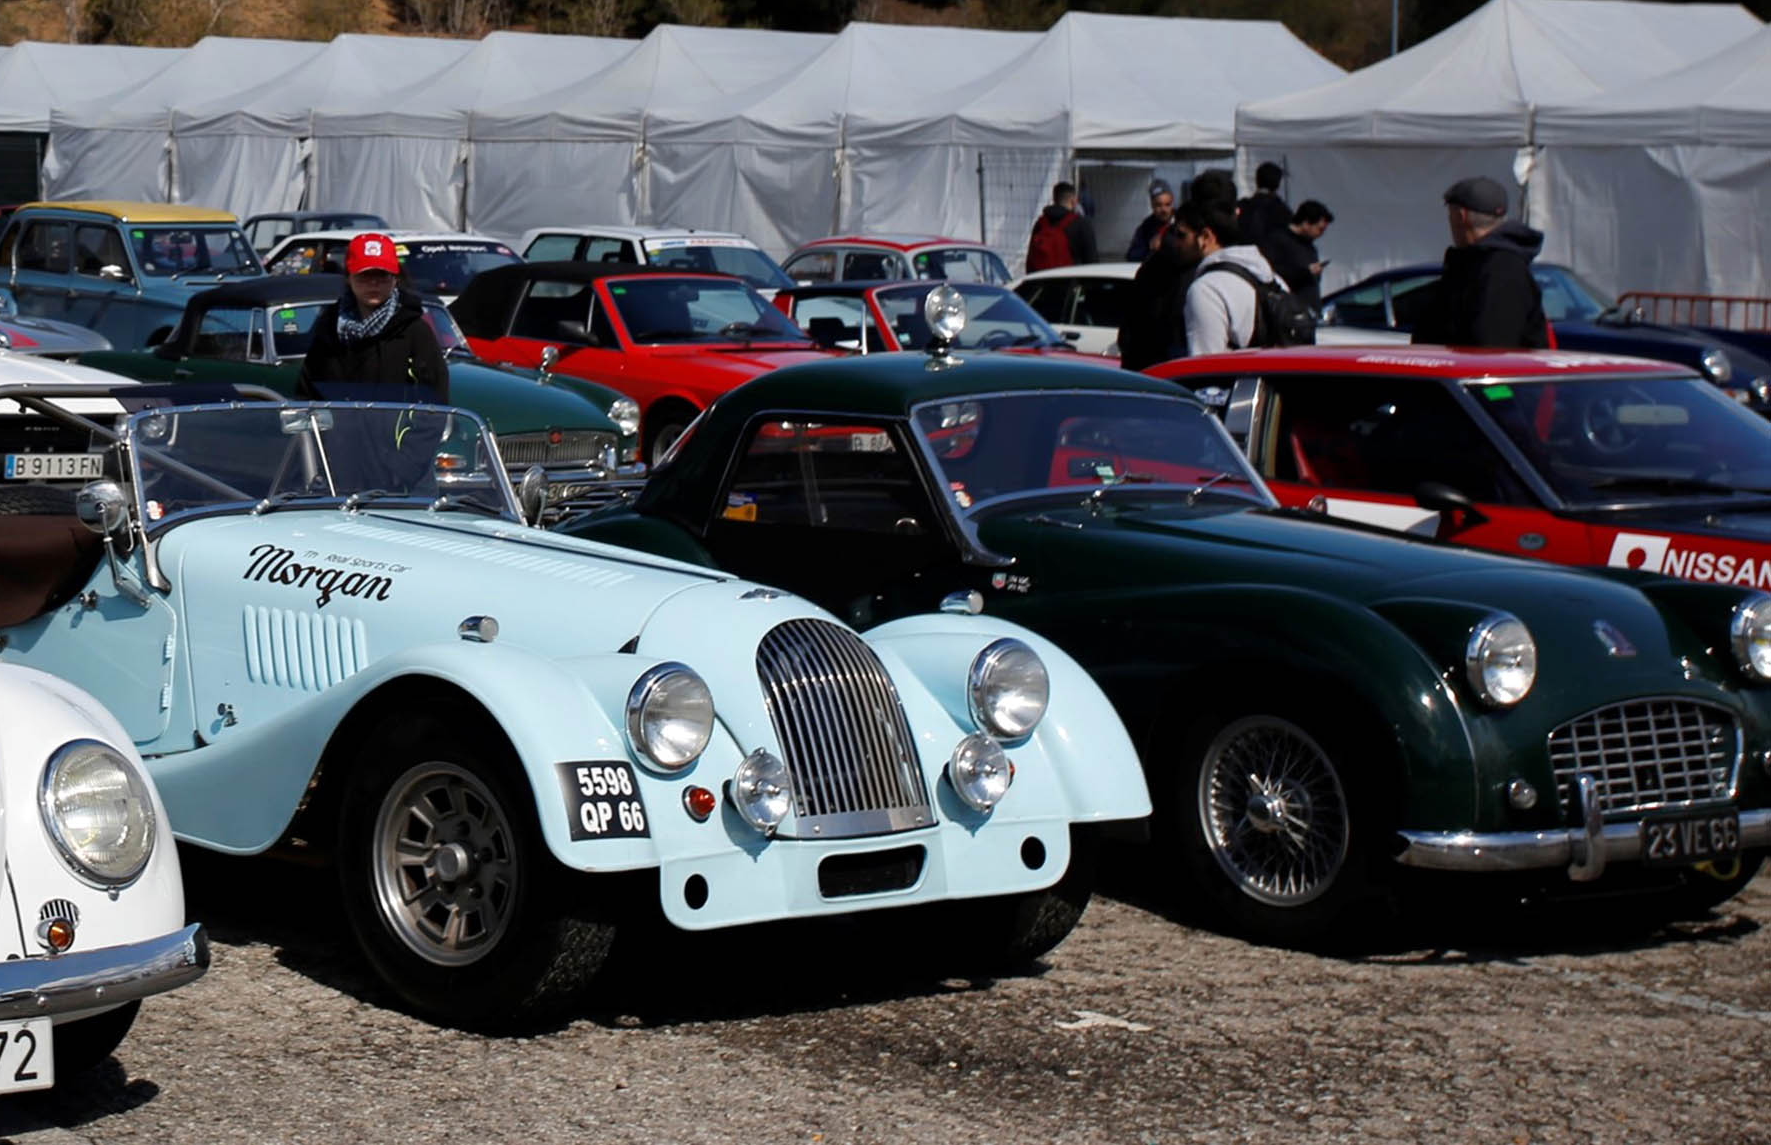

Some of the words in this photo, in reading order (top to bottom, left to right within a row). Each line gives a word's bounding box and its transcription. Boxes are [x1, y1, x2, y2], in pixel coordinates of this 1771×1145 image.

[16, 458, 25, 475] B
[32, 458, 76, 475] 9113
[80, 458, 101, 475] FN
[243, 544, 393, 609] Morgan
[325, 553, 350, 564] Real
[349, 557, 388, 570] Sports
[387, 563, 412, 573] Car
[576, 766, 633, 796] 5598
[580, 801, 613, 834] QP
[618, 801, 645, 832] 66
[1649, 824, 1677, 859] 23
